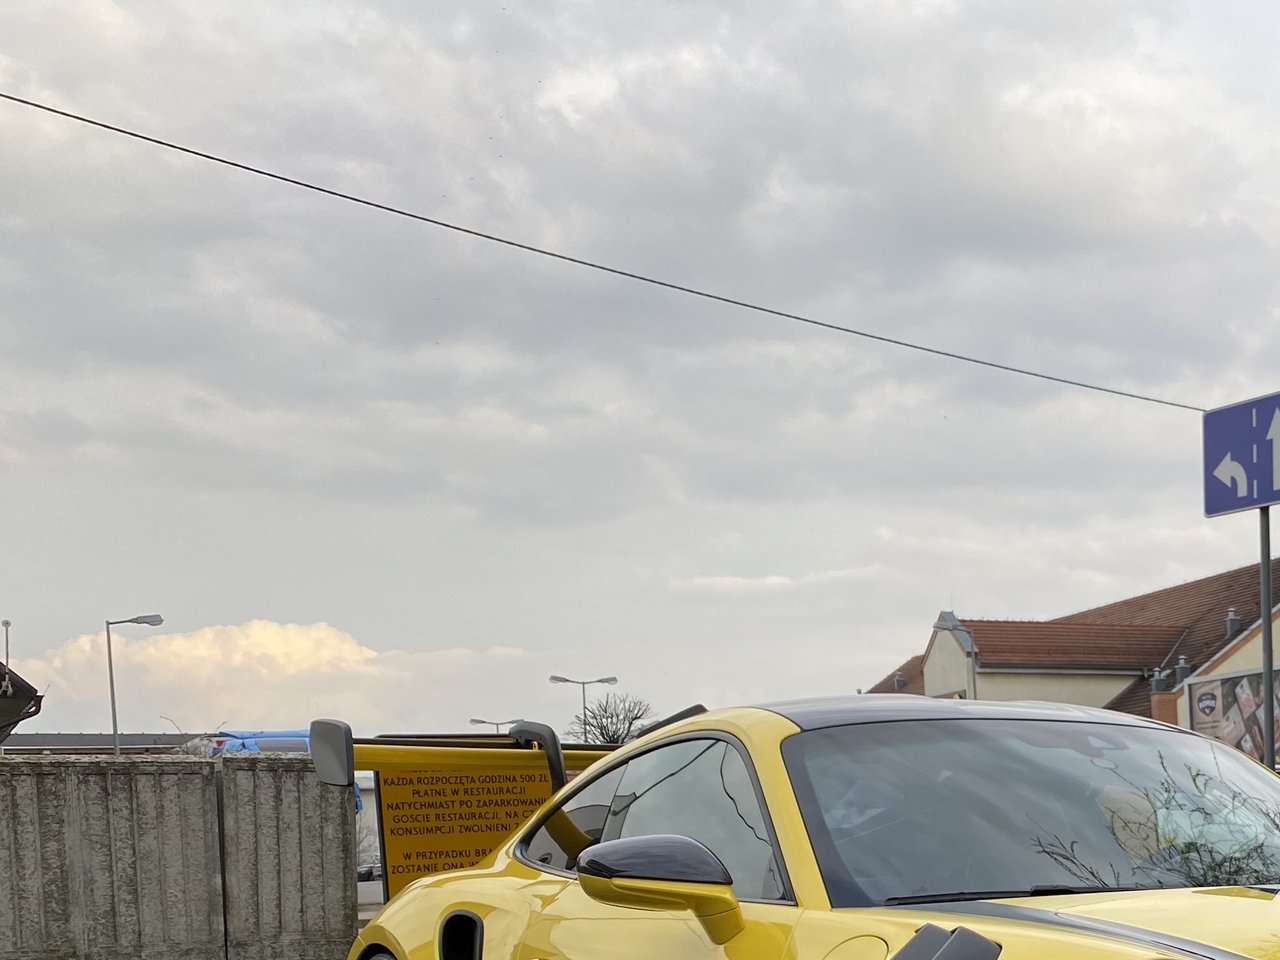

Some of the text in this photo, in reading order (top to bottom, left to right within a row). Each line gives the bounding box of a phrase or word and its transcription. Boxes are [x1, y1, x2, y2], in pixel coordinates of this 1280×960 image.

[383, 775, 414, 785] KAŻDA
[417, 775, 476, 786] ROZPOCZĘTA
[478, 775, 518, 784] GODZINA
[520, 775, 535, 783] 500
[412, 789, 447, 798] PŁATNE
[464, 787, 525, 796] RESTAURACJI
[386, 800, 456, 810] NATYCHMIAST
[460, 800, 473, 808] PO
[505, 811, 519, 819] NA
[390, 825, 455, 836] KONSUMPCJI
[459, 823, 511, 834] ZWOLNIENI
[403, 852, 412, 860] W
[416, 850, 470, 860] PRZYPADKU
[391, 864, 439, 874] ZOSTANIE
